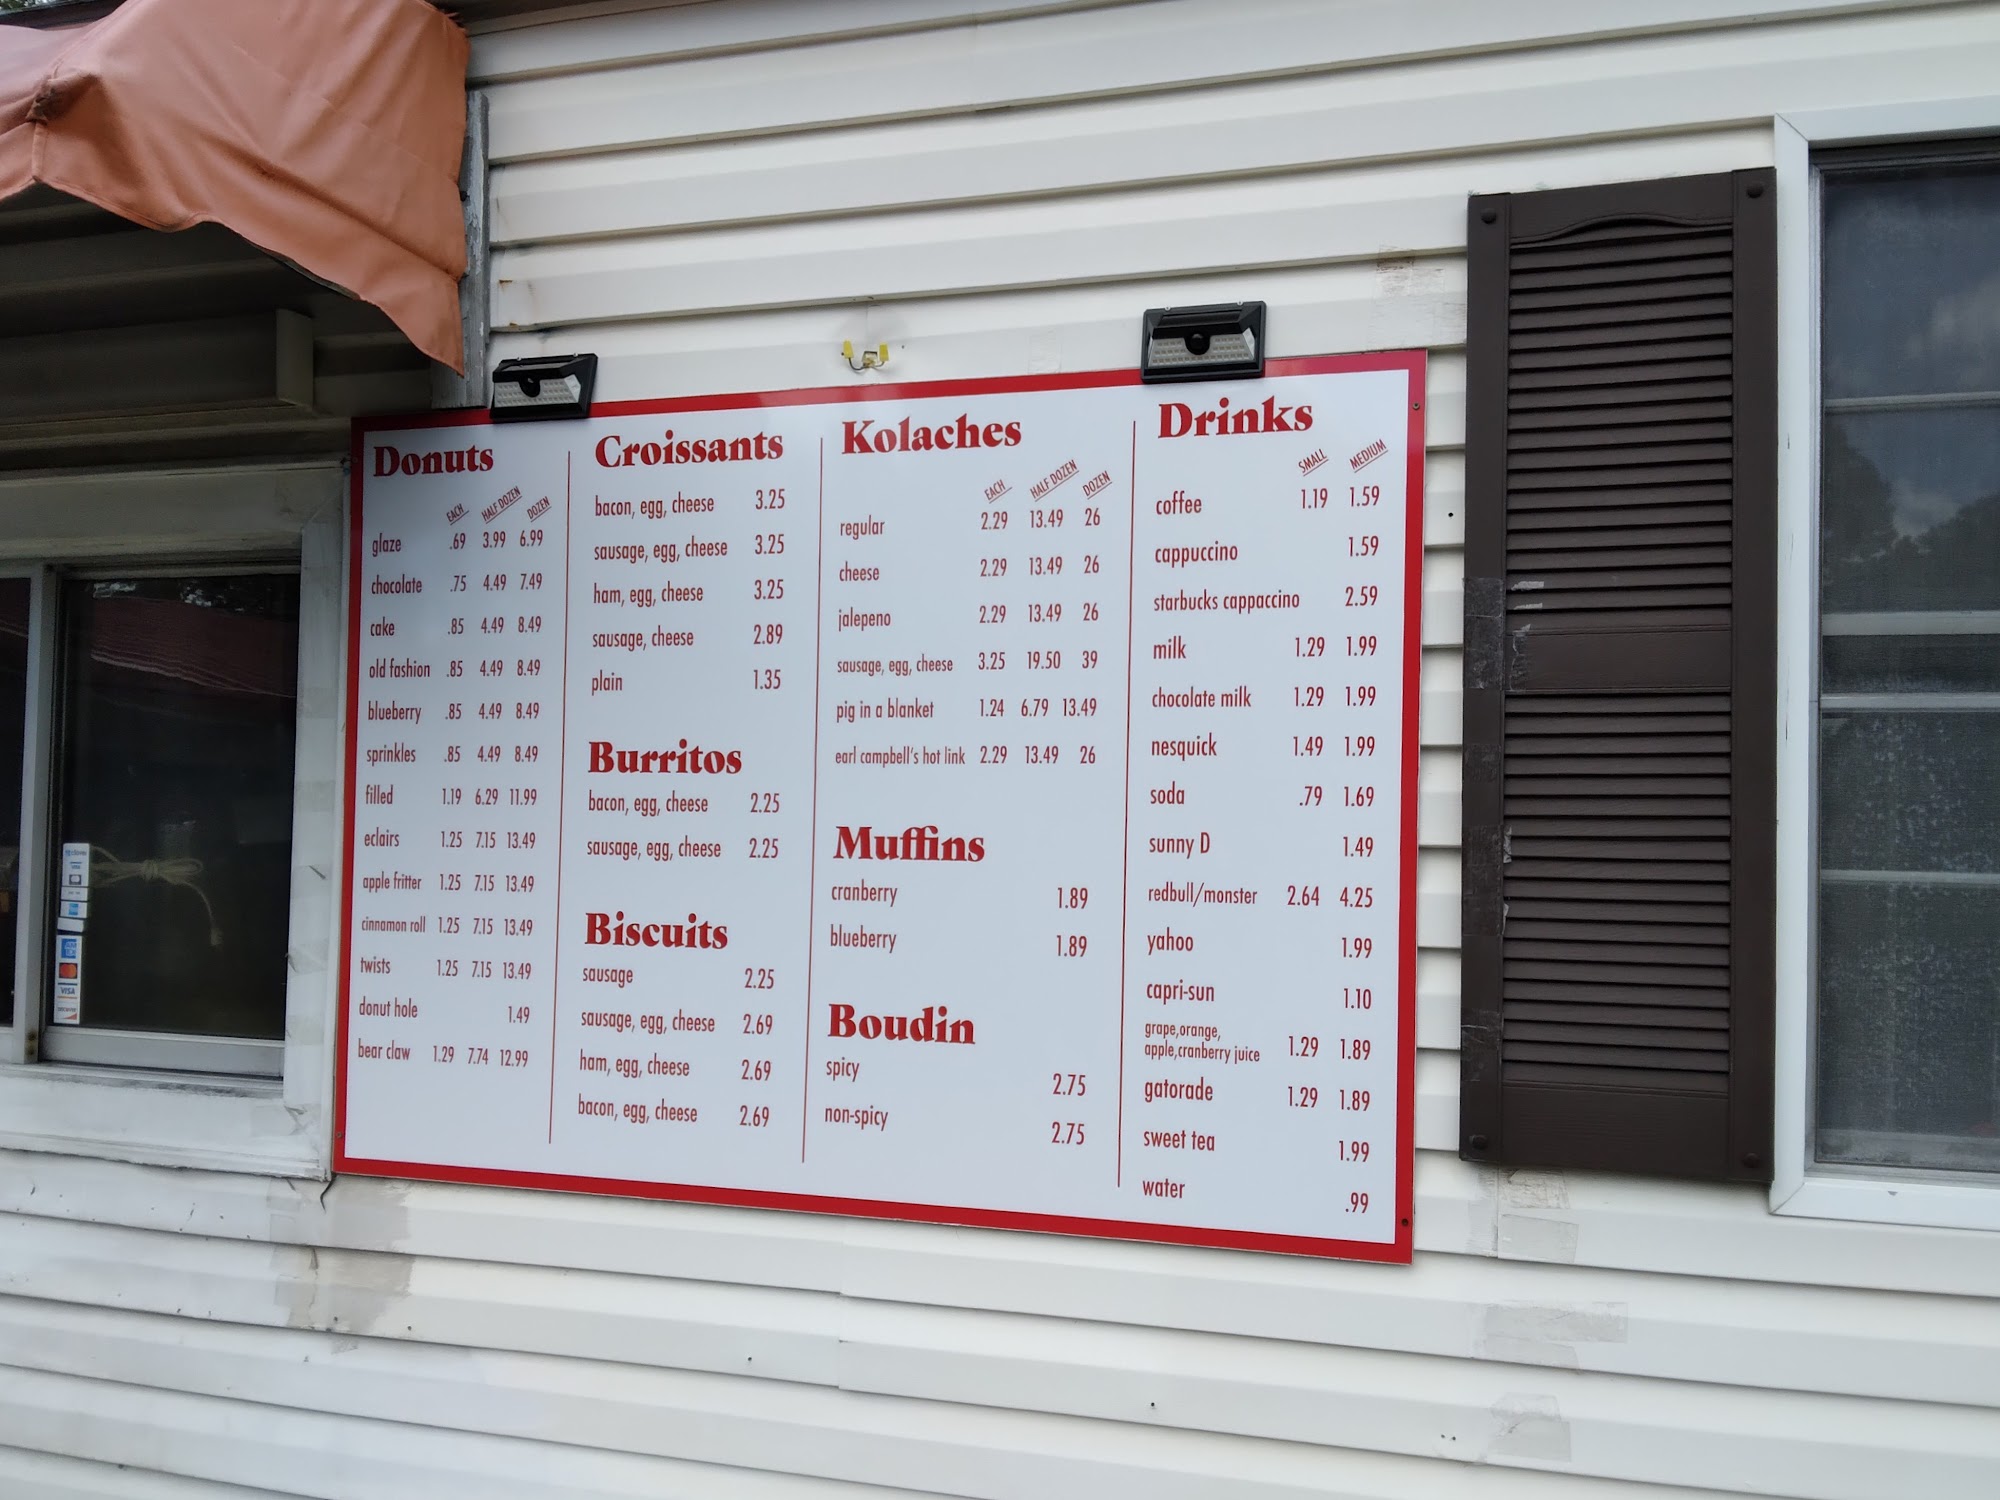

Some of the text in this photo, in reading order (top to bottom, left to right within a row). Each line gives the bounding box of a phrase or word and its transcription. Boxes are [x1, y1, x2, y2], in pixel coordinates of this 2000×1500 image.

[1157, 394, 1314, 439] Drinks
[841, 412, 1022, 455] Kolaches
[372, 444, 494, 478] Donuts
[594, 429, 784, 469] Croissants
[1298, 448, 1327, 473] SMALL
[1349, 438, 1386, 470] MEDIUM
[984, 479, 1006, 501] EACH
[1029, 459, 1077, 499] HALF DOZEN
[1082, 470, 1111, 497] DOZEN
[446, 503, 465, 523] EACH
[481, 485, 521, 522] HALF DOZEN
[526, 495, 551, 520] DOZEN
[594, 488, 786, 520] bacon, egg, cheese 3.25
[1155, 484, 1380, 516] coffee 1.19 1.59
[840, 507, 1101, 541] regular 2.29 13.49 26
[372, 529, 544, 558] glaze .69 3.99 6.99
[1154, 535, 1380, 569] cappuccino 1.59
[371, 572, 543, 595] chocolate .75 4.49 7.49
[593, 578, 784, 608] ham, egg, cheese 3.25
[1153, 585, 1378, 615] starbucks cappaccino 2.59
[592, 623, 784, 653] sausage, cheese 2.89
[368, 657, 541, 679] old fashion .85 4.49 8.49
[837, 649, 1098, 677] sausage, egg, cheese 3.25 19.50 39
[591, 668, 782, 697] plain 1.35
[1151, 684, 1377, 708] chocolate milk 1.29 1.99
[836, 696, 1098, 724] pig in a blanket 1.24 6.79 13.49
[366, 741, 539, 767] sprinkles .85 4.49 8.49
[587, 738, 743, 775] Burritos
[835, 745, 1096, 769] earl campbell's hot link 2.29 13.49 26
[365, 783, 538, 806] filled 1.19 6.29 11.99
[588, 788, 780, 818] bacon, egg, cheese 2.25
[1149, 780, 1375, 808] soda .79 1.69
[586, 834, 779, 862] sausage, egg, cheese 2.25
[832, 824, 986, 863] Muffins
[1148, 831, 1374, 860] sunny D 1.49
[362, 870, 535, 894] apple fritter 1.25 7.15 13.49
[831, 878, 1089, 910] cranberry 1.89
[1148, 880, 1373, 909] redbull/monster 2.64 4.25
[361, 915, 533, 937] cinnamon roll 1.25 7.15 13.49
[584, 910, 729, 950] Biscuits
[60, 987, 76, 995] VISA
[582, 967, 775, 990] sausage 2.25
[358, 995, 531, 1024] donut hole 1.49
[580, 1008, 773, 1036] sausage, egg, cheese 2.69
[826, 1003, 976, 1045] Boudin
[1144, 1022, 1222, 1042] grape,orange,
[357, 1037, 529, 1068] bear claw 1.29 7.74 12.99
[1144, 1035, 1371, 1065] apple,cranberry juice 1.29 1.89
[826, 1056, 1086, 1097] spicy 2.75
[824, 1104, 1085, 1146] non-spicy 2.75
[1143, 1129, 1370, 1163] sweet tea 1.99
[1142, 1177, 1369, 1214] water .99
